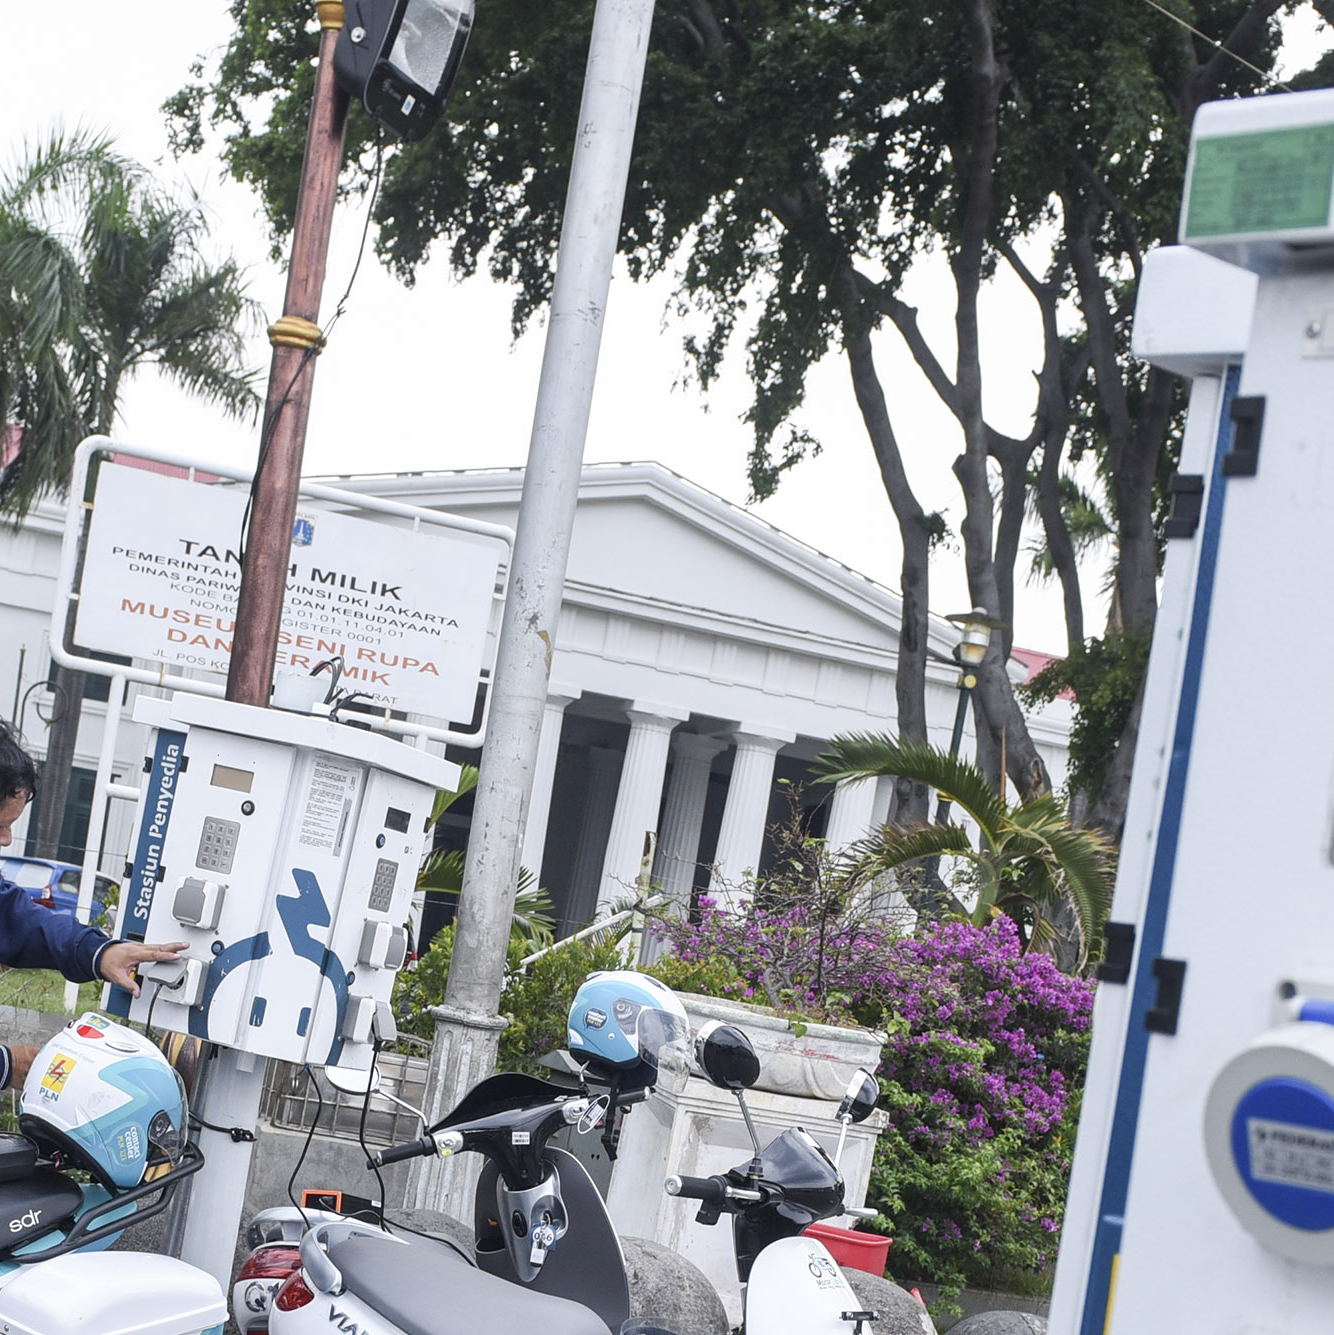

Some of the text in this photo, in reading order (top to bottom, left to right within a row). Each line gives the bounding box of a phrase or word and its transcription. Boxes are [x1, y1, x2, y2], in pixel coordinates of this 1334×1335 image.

[112, 546, 237, 580] PEMERINTAH
[338, 594, 369, 608] DKI
[374, 604, 459, 628] JAKARTA
[129, 563, 180, 581] DINAS
[291, 597, 326, 611] DAN
[331, 605, 442, 636] KEBUDAYAAN
[310, 567, 404, 601] MILIK
[170, 583, 217, 599] KODE
[297, 610, 405, 638] 01.01.11.04.01
[167, 628, 233, 653] DAN
[277, 631, 346, 657] SENI
[357, 647, 440, 676] RUPA
[347, 633, 382, 645] 0001
[152, 649, 171, 659] JL.
[176, 654, 206, 666] POS
[133, 744, 180, 921] Stasiun Penyedia
[39, 1086, 60, 1102] PLN
[124, 1131, 134, 1159] center
[130, 1126, 141, 1159] contact
[8, 1208, 43, 1233] sdr
